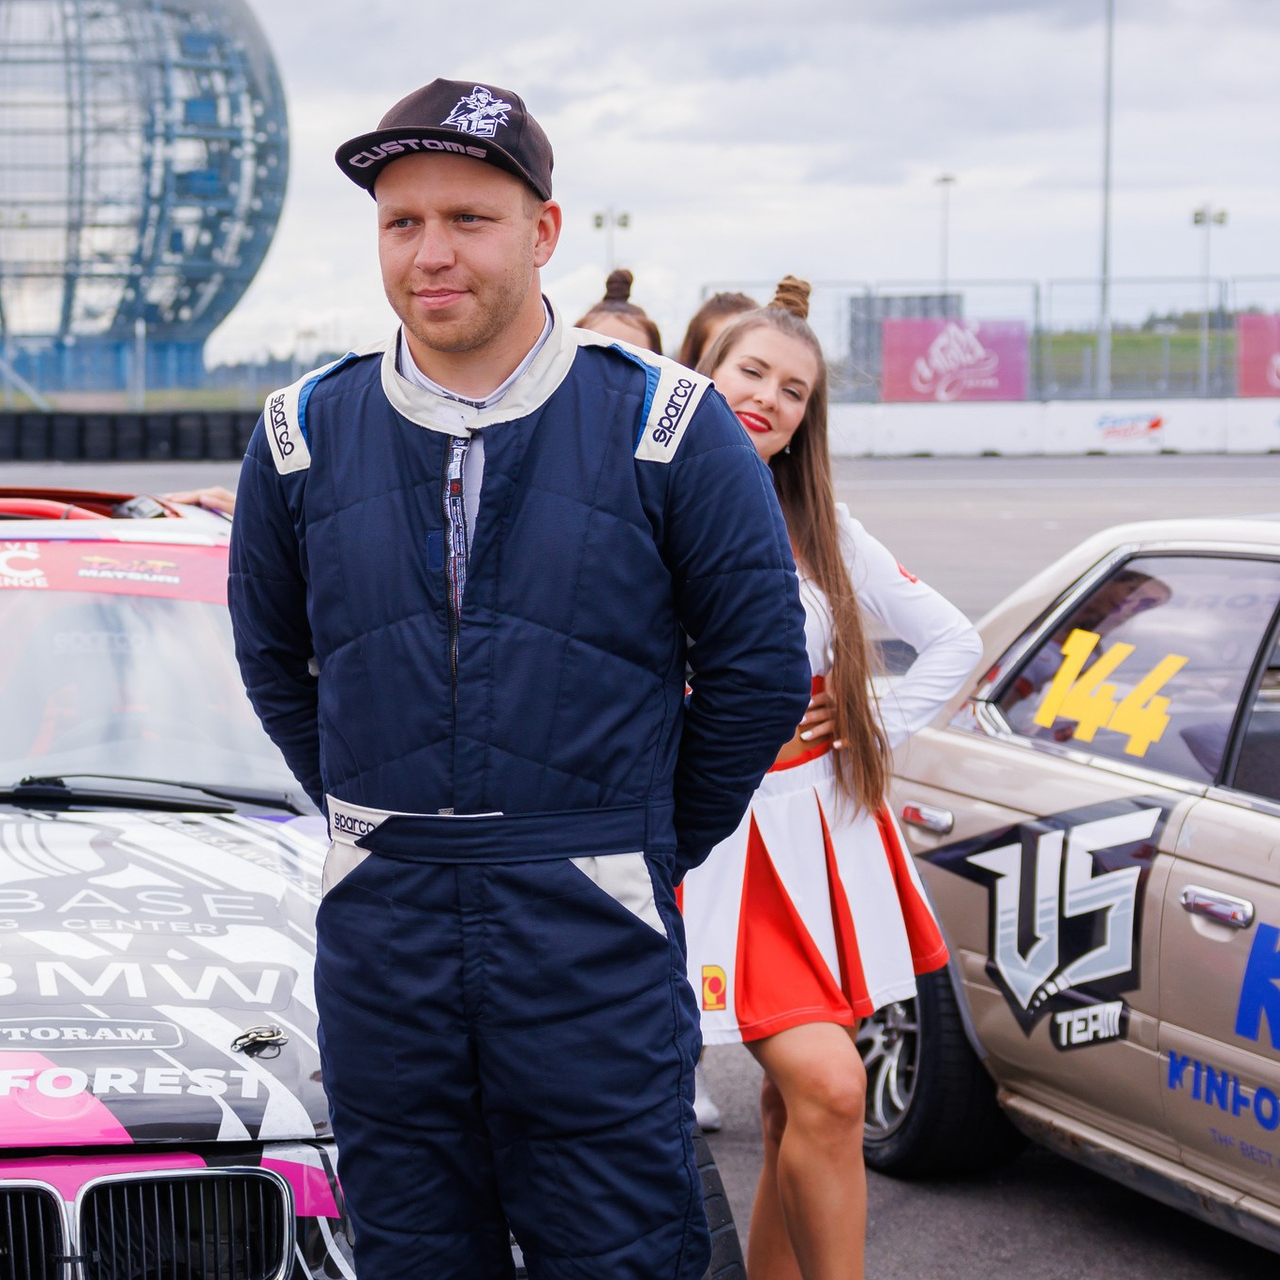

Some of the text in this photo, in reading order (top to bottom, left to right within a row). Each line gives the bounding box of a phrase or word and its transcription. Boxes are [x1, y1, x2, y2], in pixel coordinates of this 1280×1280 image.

[349, 139, 487, 168] CUSTOMS
[269, 394, 294, 458] sparco
[652, 378, 694, 444] sparco
[1033, 627, 1190, 758] 144
[61, 918, 219, 936] CENTER
[1055, 1000, 1124, 1046] TEAM
[1240, 1140, 1274, 1169] BEST
